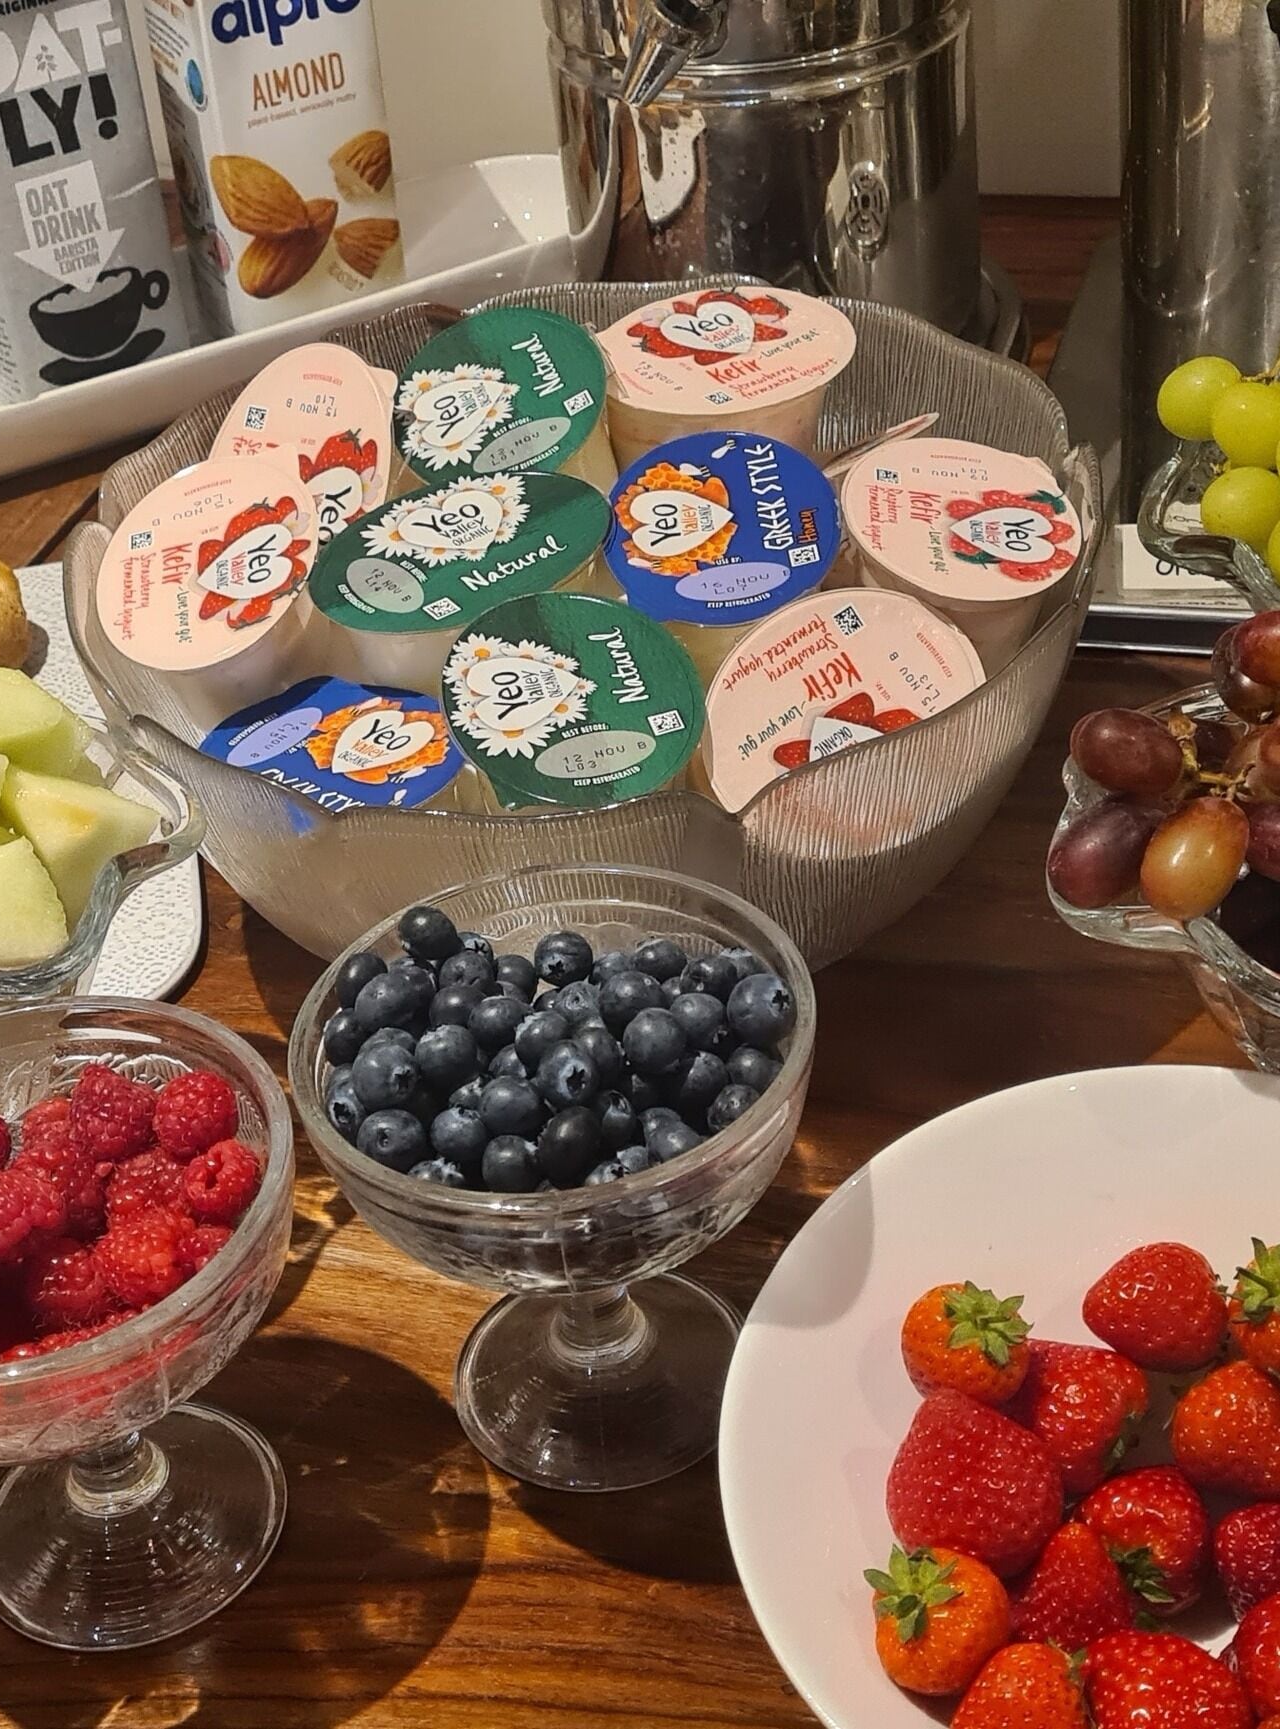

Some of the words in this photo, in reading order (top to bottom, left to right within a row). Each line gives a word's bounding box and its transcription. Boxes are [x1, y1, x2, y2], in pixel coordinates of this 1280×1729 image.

[252, 52, 346, 111] ALMOND
[25, 178, 69, 218] OAT
[31, 202, 102, 248] DRINK
[53, 237, 100, 262] BARISTA
[59, 253, 101, 276] EDITION
[672, 313, 735, 337] Yeo
[510, 332, 565, 398] Natural
[706, 358, 762, 385] Kefir
[728, 365, 799, 393] Strawberry
[740, 374, 799, 400] fermented
[800, 358, 838, 385] yogurt
[433, 394, 466, 439] Yeo
[458, 389, 480, 418] Valley
[743, 442, 783, 495] STYLE
[410, 503, 481, 533] Yeo
[681, 503, 697, 537] Valley
[756, 496, 795, 550] GREEK
[884, 486, 904, 524] Raspberry
[908, 489, 942, 525] Kefir
[439, 516, 485, 540] Valley
[451, 525, 494, 547] ORGANIC
[649, 503, 682, 547] Yeo
[796, 506, 820, 545] Honey
[984, 520, 1001, 548] Valley
[1002, 518, 1036, 553] Yeo
[161, 542, 193, 585] Kefir
[230, 551, 247, 587] Valley
[246, 533, 277, 584] Yeo
[460, 534, 568, 592] Natural
[120, 556, 140, 608] fermented
[134, 552, 157, 610] Strawberry
[724, 592, 771, 608] REFRIGERATED
[113, 608, 136, 641] yogurt
[762, 613, 827, 664] fermented
[587, 626, 650, 704] Natural
[722, 652, 764, 692] yogurt
[768, 632, 839, 683] Strawberry
[888, 651, 899, 662] B
[521, 669, 545, 705] Valley
[801, 651, 863, 702] Kefir
[491, 671, 529, 721] Yeo
[561, 728, 580, 739] BEST
[580, 723, 609, 735] BEFORE:
[757, 718, 781, 744] your
[777, 704, 804, 727] Love
[350, 739, 389, 759] Valley
[362, 718, 412, 750] Yeo
[562, 753, 583, 765] 12
[637, 741, 648, 750] B
[565, 760, 597, 774] L03
[573, 777, 592, 787] KEEP
[592, 765, 642, 785] REFRIGERATED
